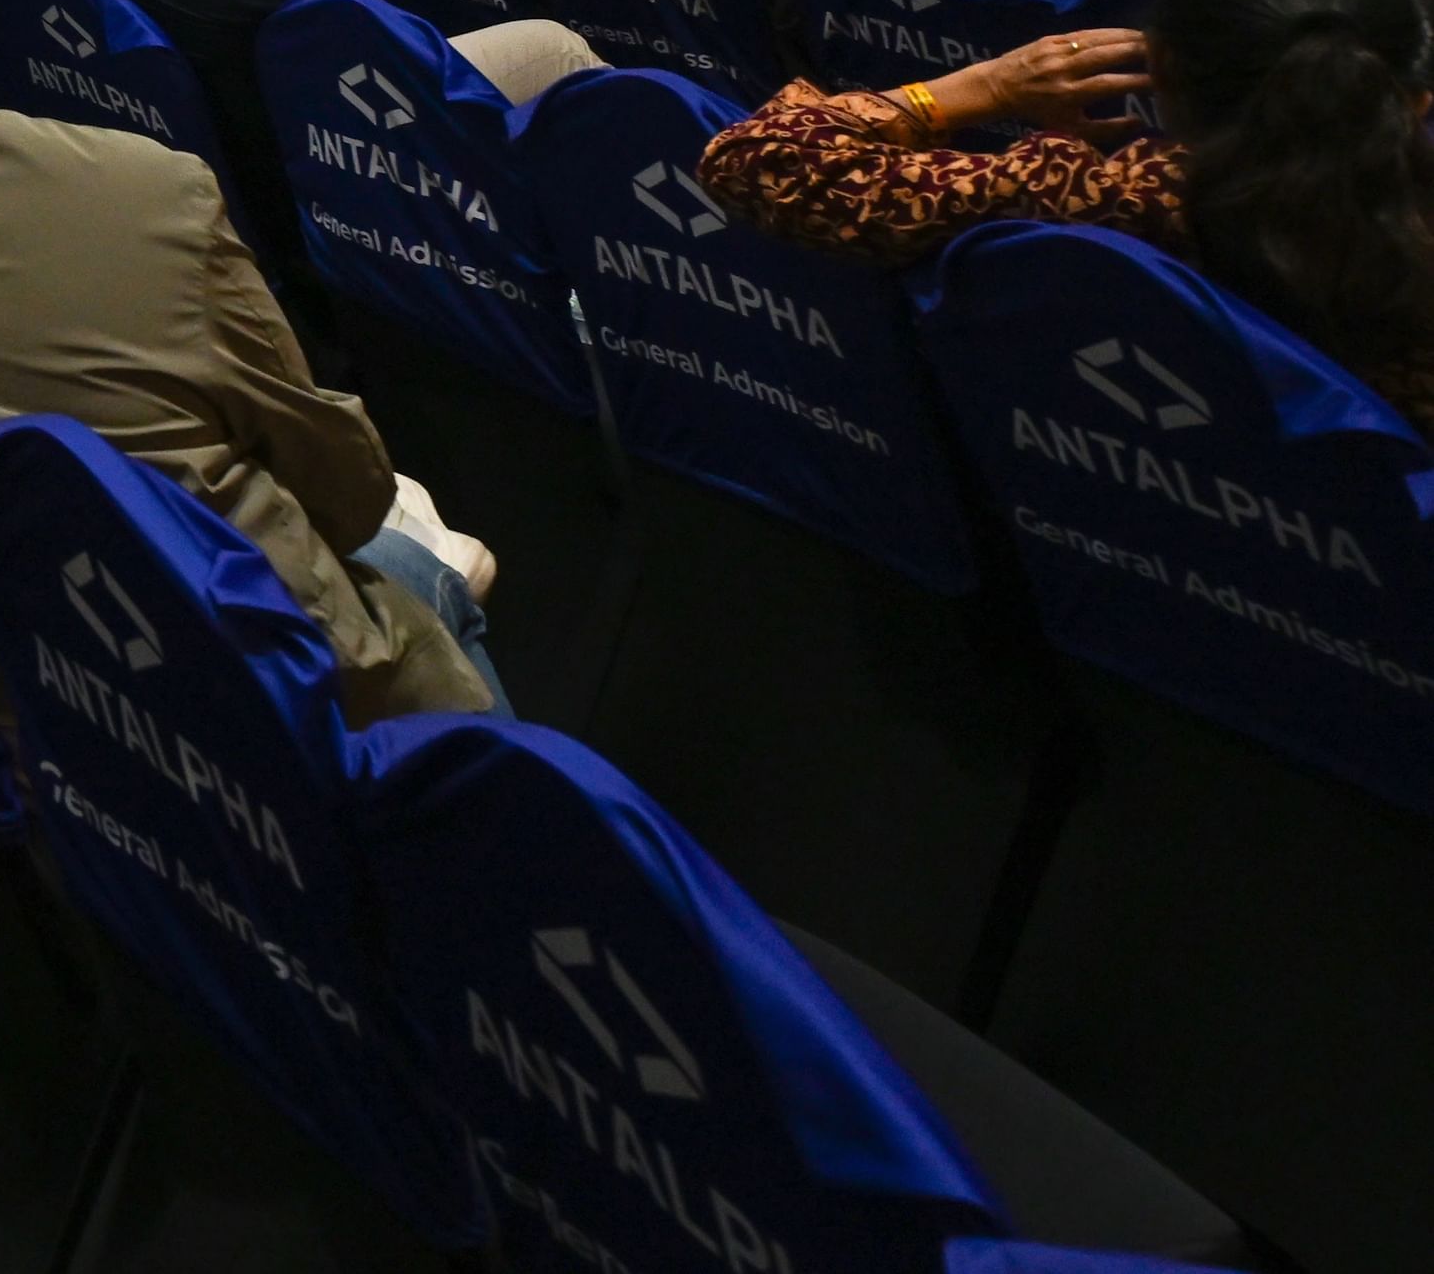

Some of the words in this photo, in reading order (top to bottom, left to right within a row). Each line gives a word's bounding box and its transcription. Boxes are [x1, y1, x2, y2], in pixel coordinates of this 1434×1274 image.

[27, 56, 174, 141] ANTALPHA
[306, 123, 499, 234] ANTALPHA
[311, 199, 380, 251] General
[594, 235, 844, 359] ANTALPHA
[599, 323, 704, 379] General
[712, 361, 891, 455] Admission
[1012, 407, 1382, 588] ANTALPHA
[1014, 505, 1171, 585] General
[35, 633, 304, 893] ANTALPHA
